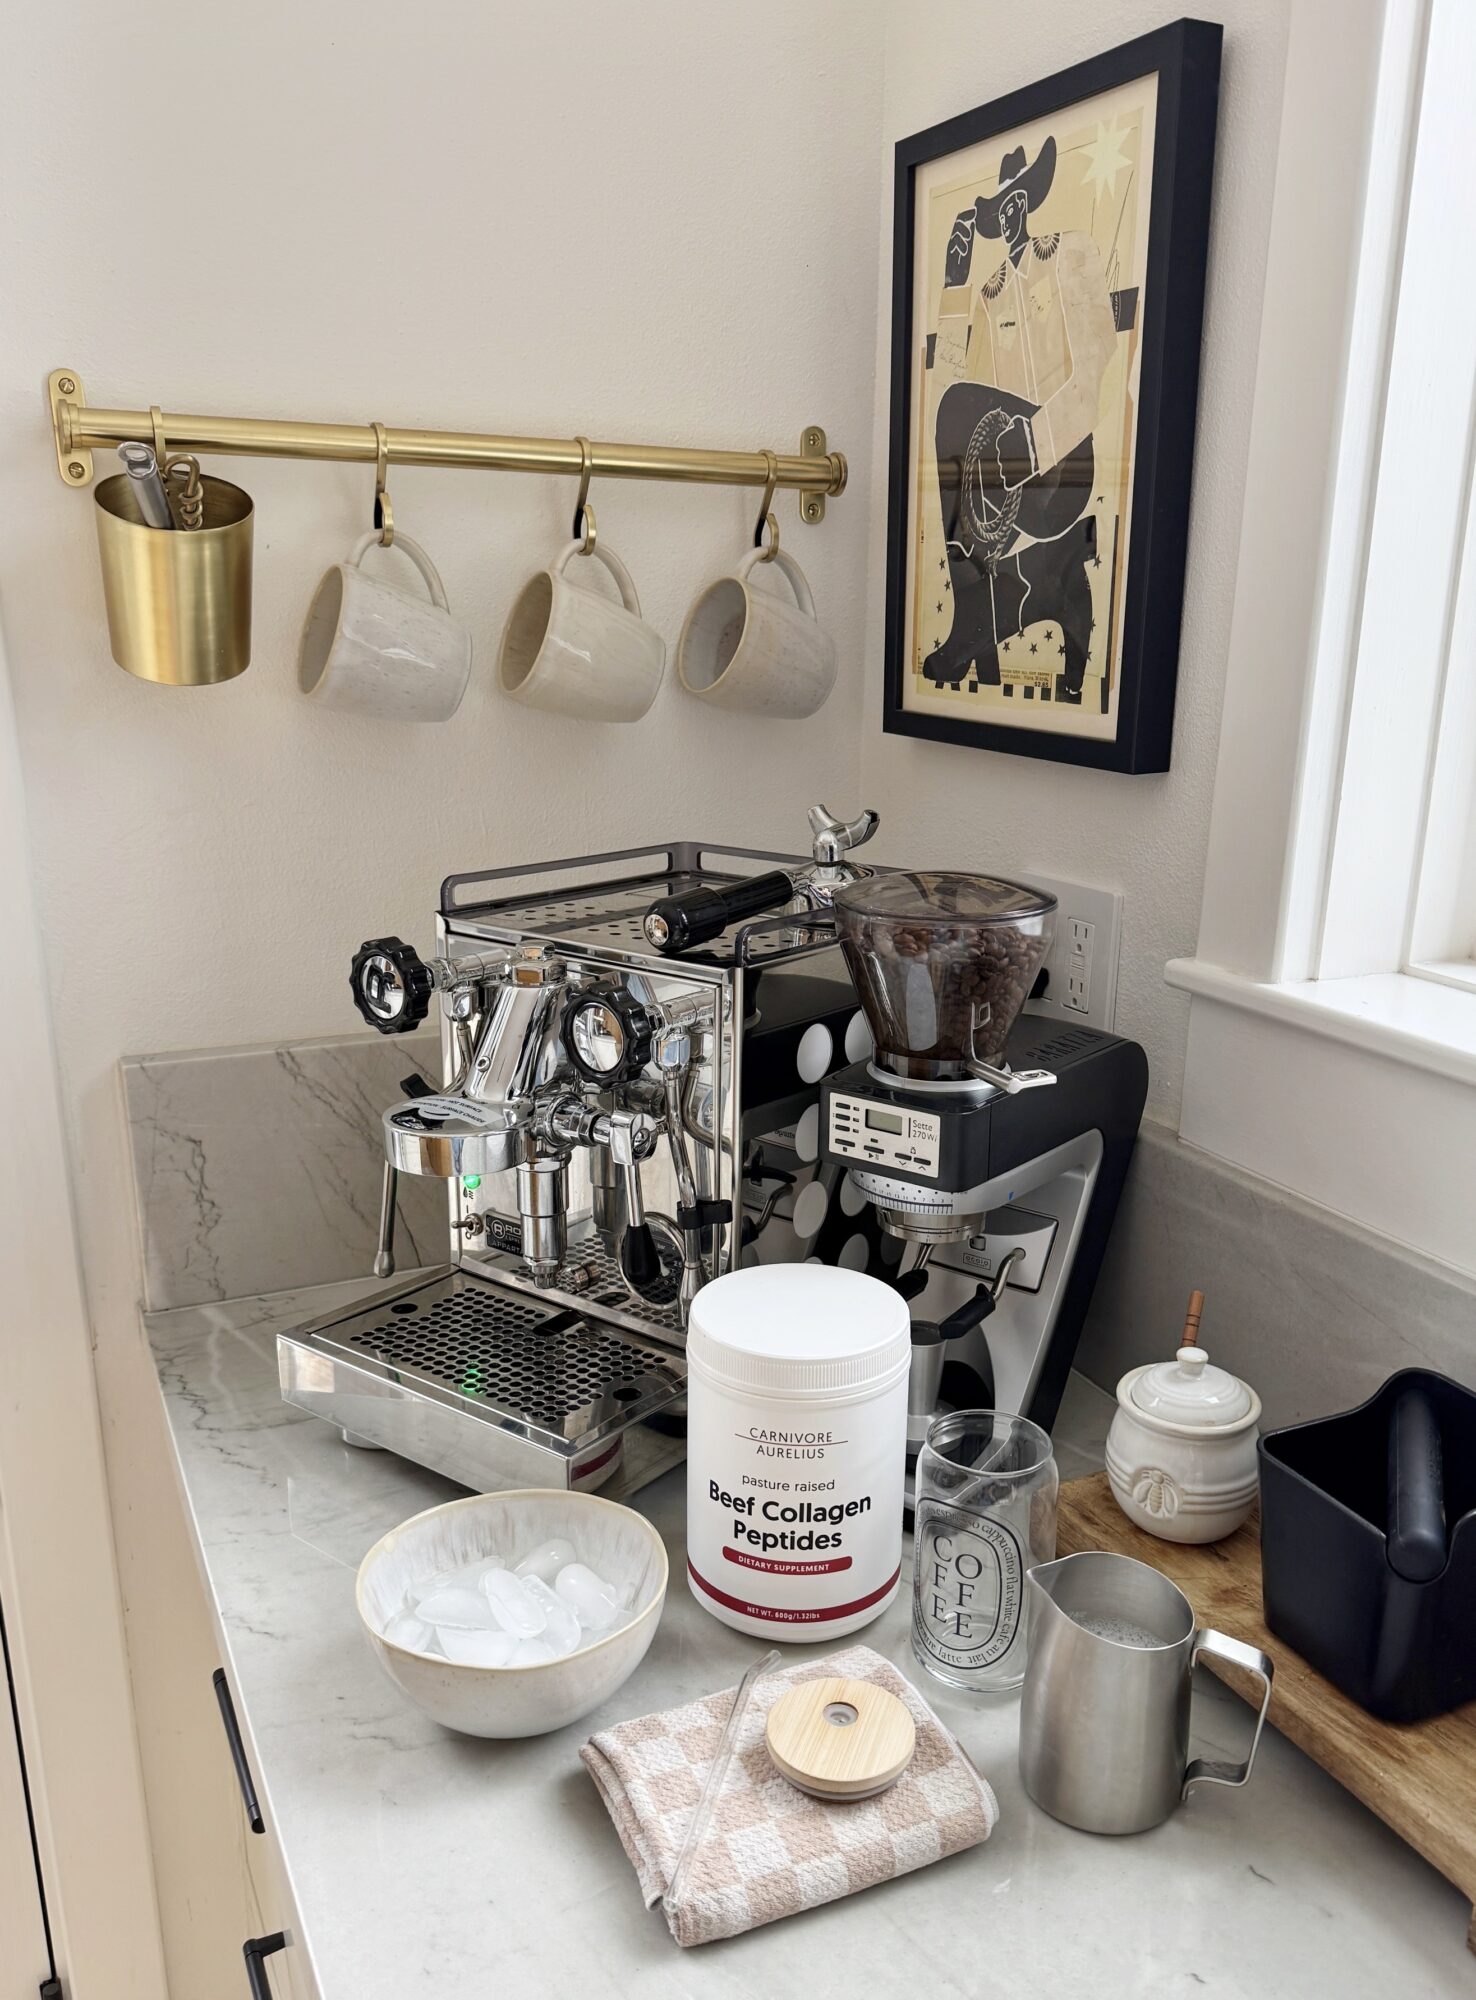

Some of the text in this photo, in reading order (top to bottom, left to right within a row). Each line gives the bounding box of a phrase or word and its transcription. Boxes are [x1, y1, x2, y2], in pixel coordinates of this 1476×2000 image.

[913, 1120, 933, 1131] Sette
[749, 1427, 832, 1444] CARNIVORE
[756, 1444, 825, 1459] AURELIUS
[742, 1475, 835, 1492] pasture raised
[709, 1479, 871, 1525] Beef Collagen
[734, 1519, 842, 1552] Peptides
[981, 1525, 1015, 1575] cappuccino
[738, 1556, 829, 1572] DIETARY SUPPLEMENT
[747, 1606, 759, 1614] NET
[761, 1609, 774, 1617] WT.
[938, 1646, 962, 1663] latte
